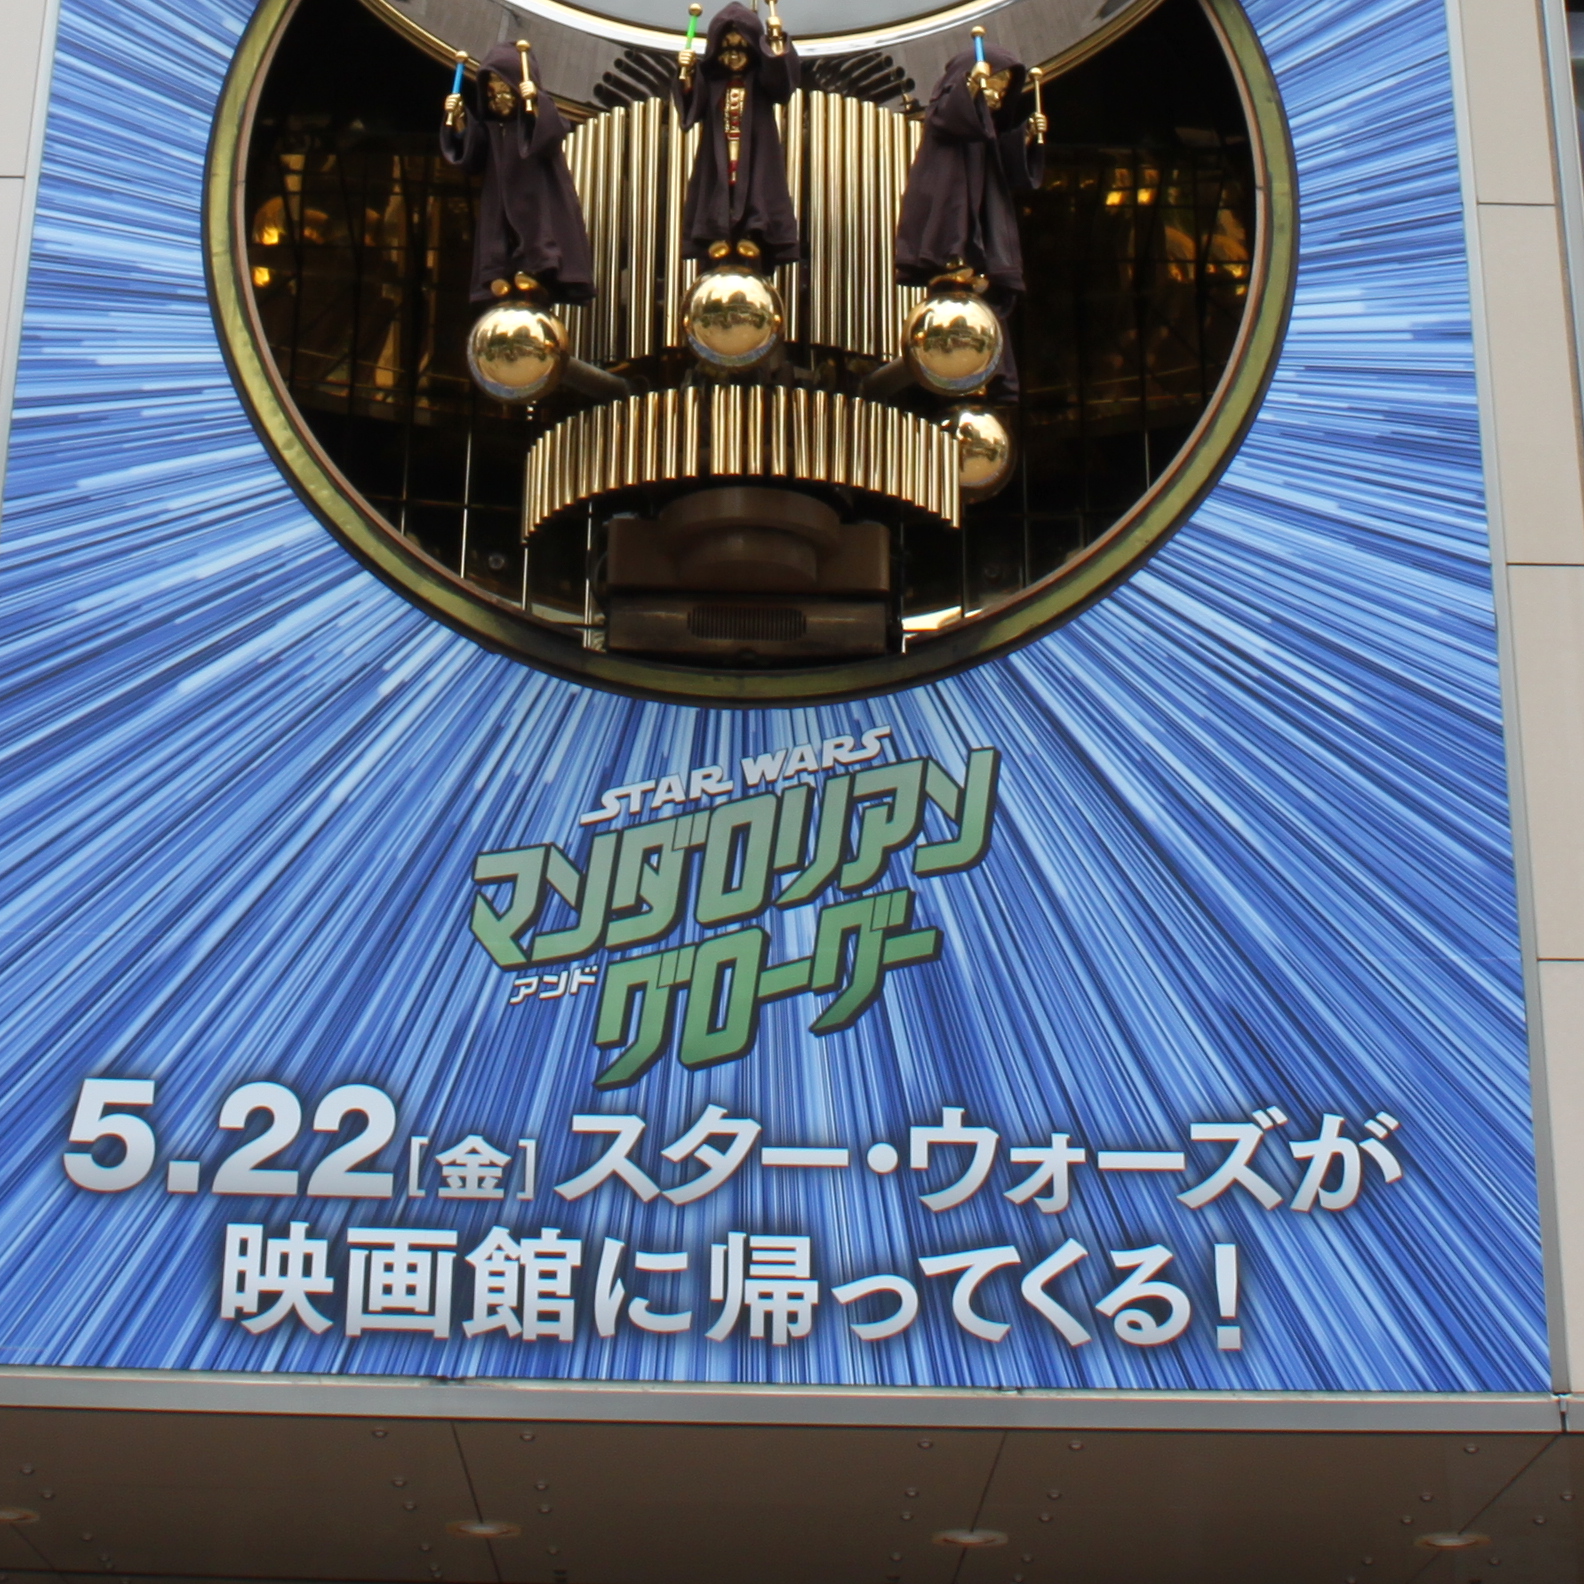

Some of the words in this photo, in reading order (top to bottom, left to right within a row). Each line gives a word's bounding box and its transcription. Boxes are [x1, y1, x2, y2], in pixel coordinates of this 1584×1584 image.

[579, 764, 734, 826] STAR
[740, 724, 891, 786] WARS
[471, 746, 1001, 971] マンダロリアン
[510, 966, 599, 1004] アンド
[593, 888, 944, 1091] グローグー
